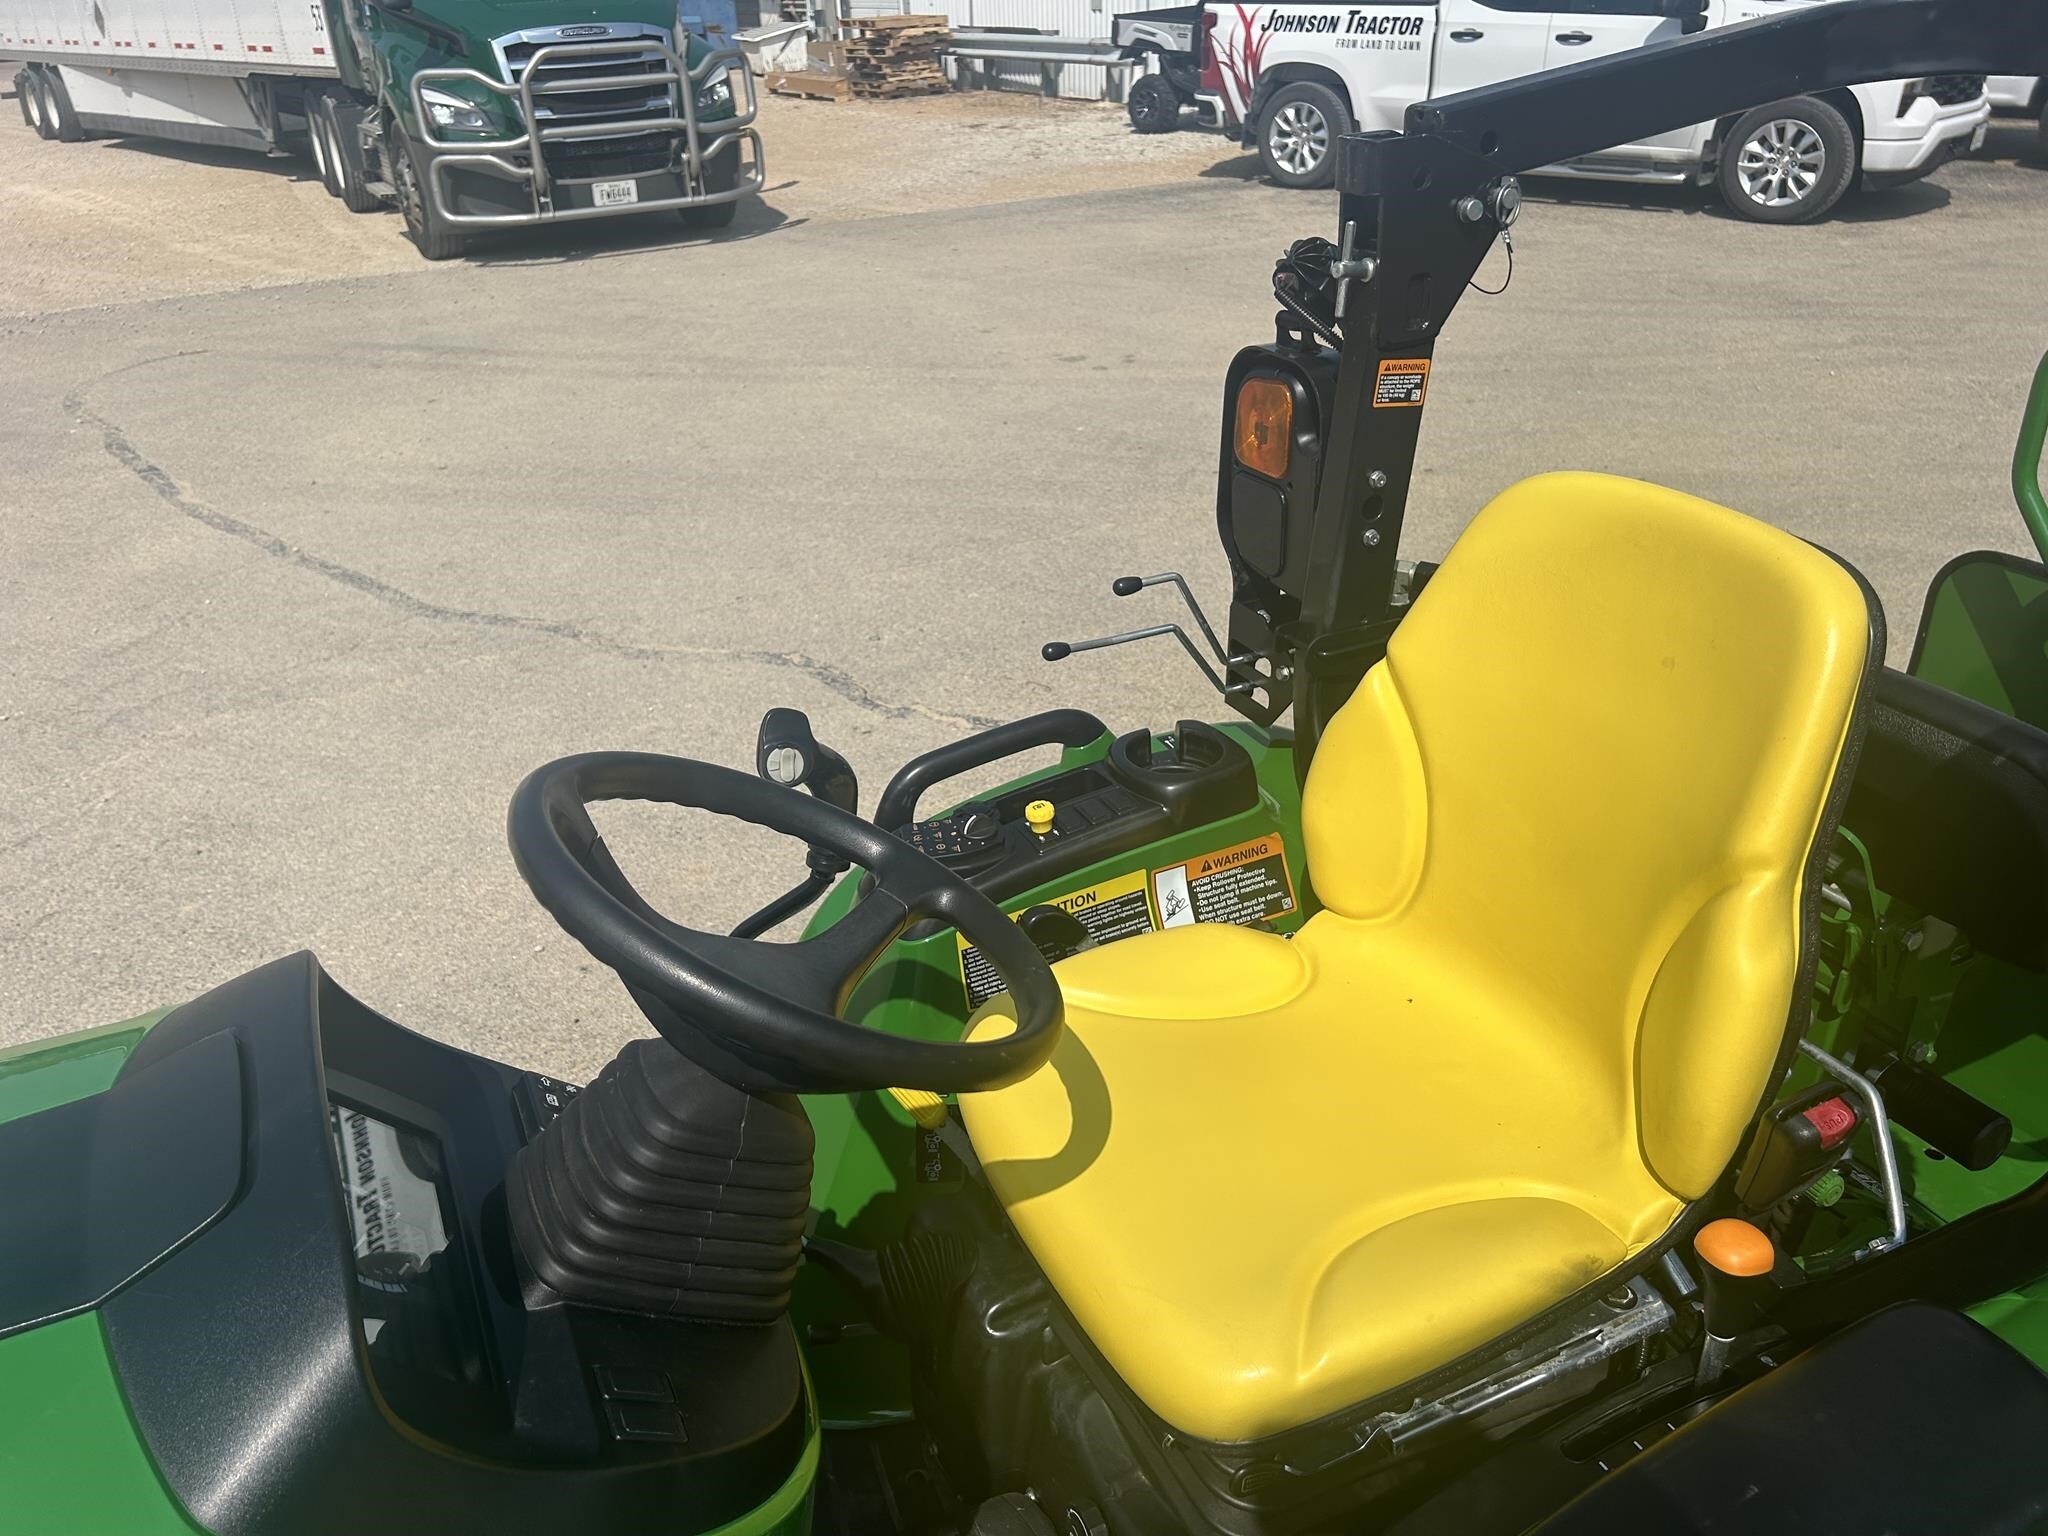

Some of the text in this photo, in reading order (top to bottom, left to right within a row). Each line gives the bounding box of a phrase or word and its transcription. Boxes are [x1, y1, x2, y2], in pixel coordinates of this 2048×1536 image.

[1261, 9, 1424, 36] JOHNSON TRACTOR
[1335, 38, 1422, 51] FROM LAND TO LAWN
[1391, 363, 1426, 371] WARNING
[1213, 844, 1268, 868] WARNING
[1192, 867, 1244, 887] AVOID CRUSHING:
[1212, 877, 1236, 888] Rollover
[1237, 868, 1265, 880] Protective
[1197, 887, 1225, 899] Structure
[1225, 883, 1238, 892] fully
[1209, 895, 1219, 903] not
[1220, 892, 1234, 902] jump
[1240, 883, 1264, 894] machine
[1199, 911, 1216, 920] When
[1217, 904, 1242, 915] structure
[1243, 899, 1258, 907] must
[1215, 914, 1228, 922] NOT
[1236, 916, 1250, 924] extra
